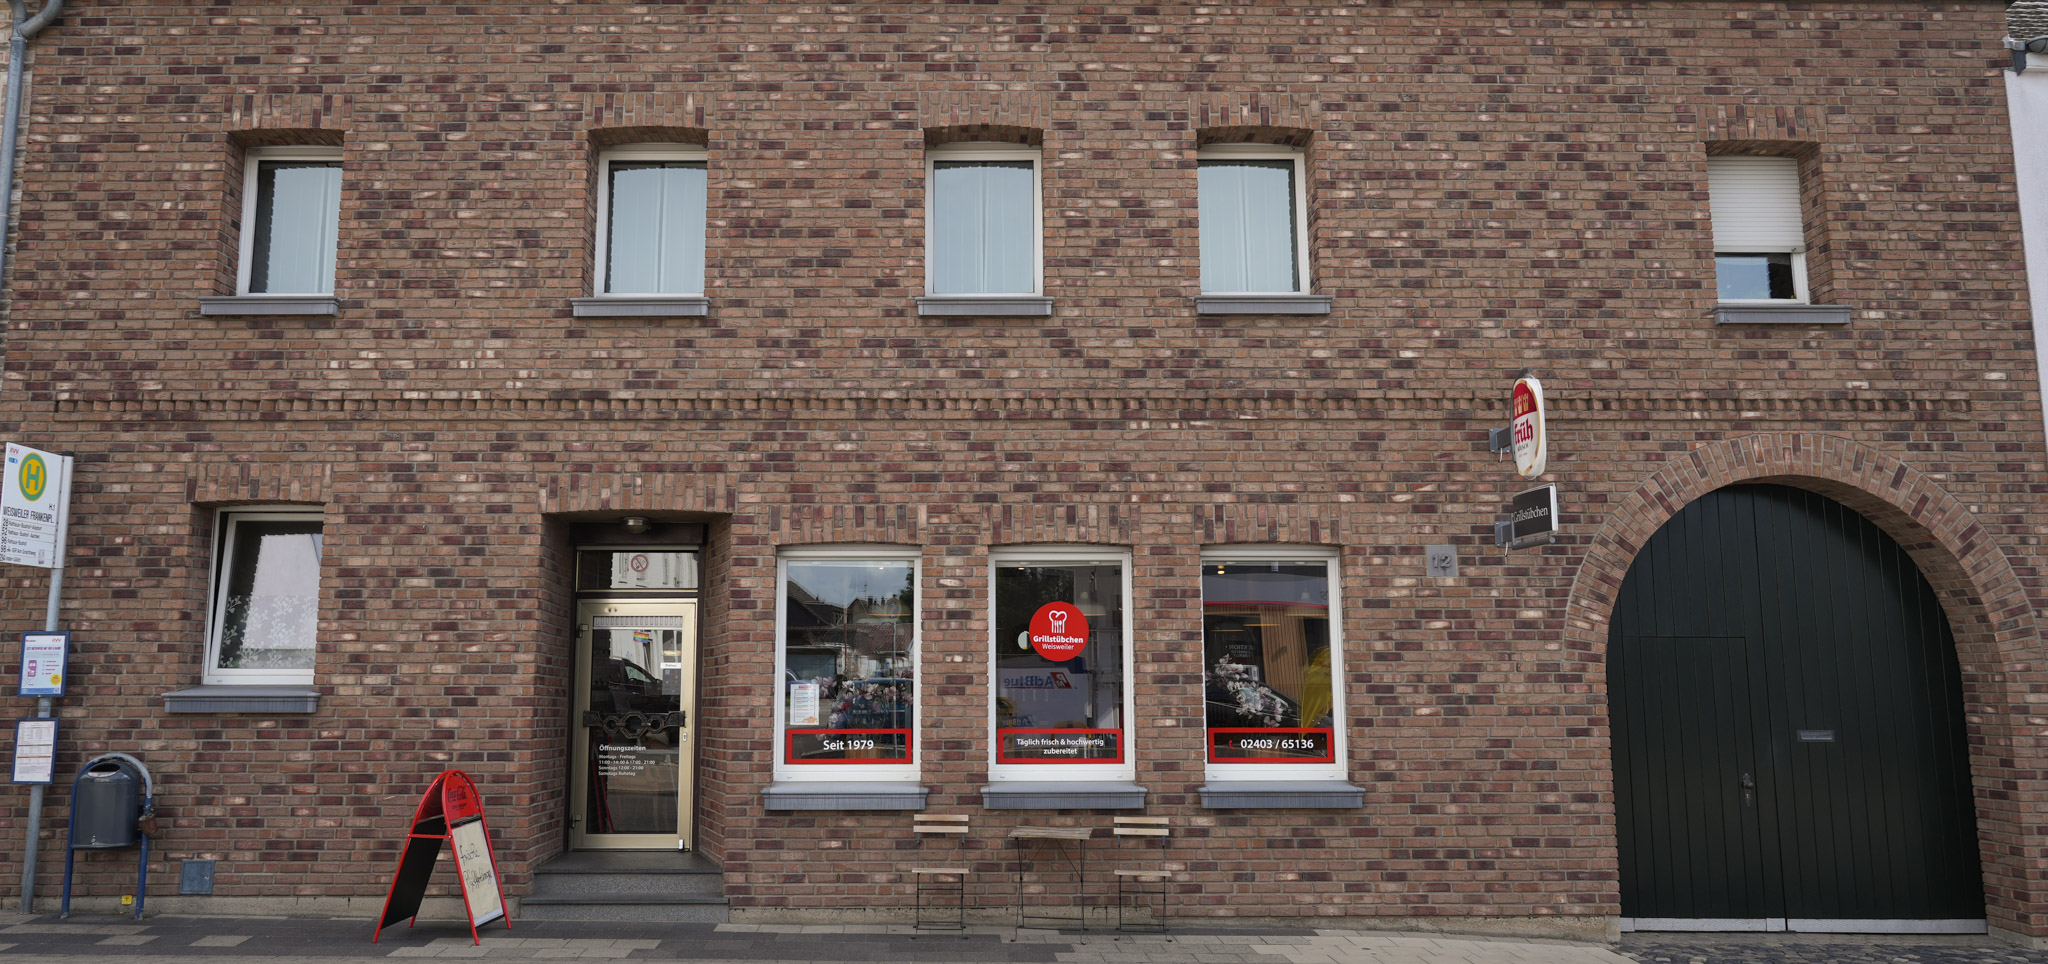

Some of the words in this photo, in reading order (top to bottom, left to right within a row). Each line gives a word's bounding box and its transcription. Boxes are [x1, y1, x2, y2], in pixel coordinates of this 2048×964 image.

[25, 463, 41, 491] H
[3, 505, 29, 519] WEISWEILER
[1513, 506, 1549, 523] Grillstübchen
[1432, 554, 1451, 569] 12
[1033, 635, 1084, 643] Grillstübchen
[599, 744, 646, 752] Öffnungszeiten
[823, 739, 845, 750] Seit
[847, 739, 874, 750] 1979
[1016, 738, 1040, 747] Täglich
[1066, 738, 1104, 747] hochwertig
[1240, 739, 1273, 749] 02403
[1275, 739, 1280, 750] /
[1281, 739, 1314, 749] 65136
